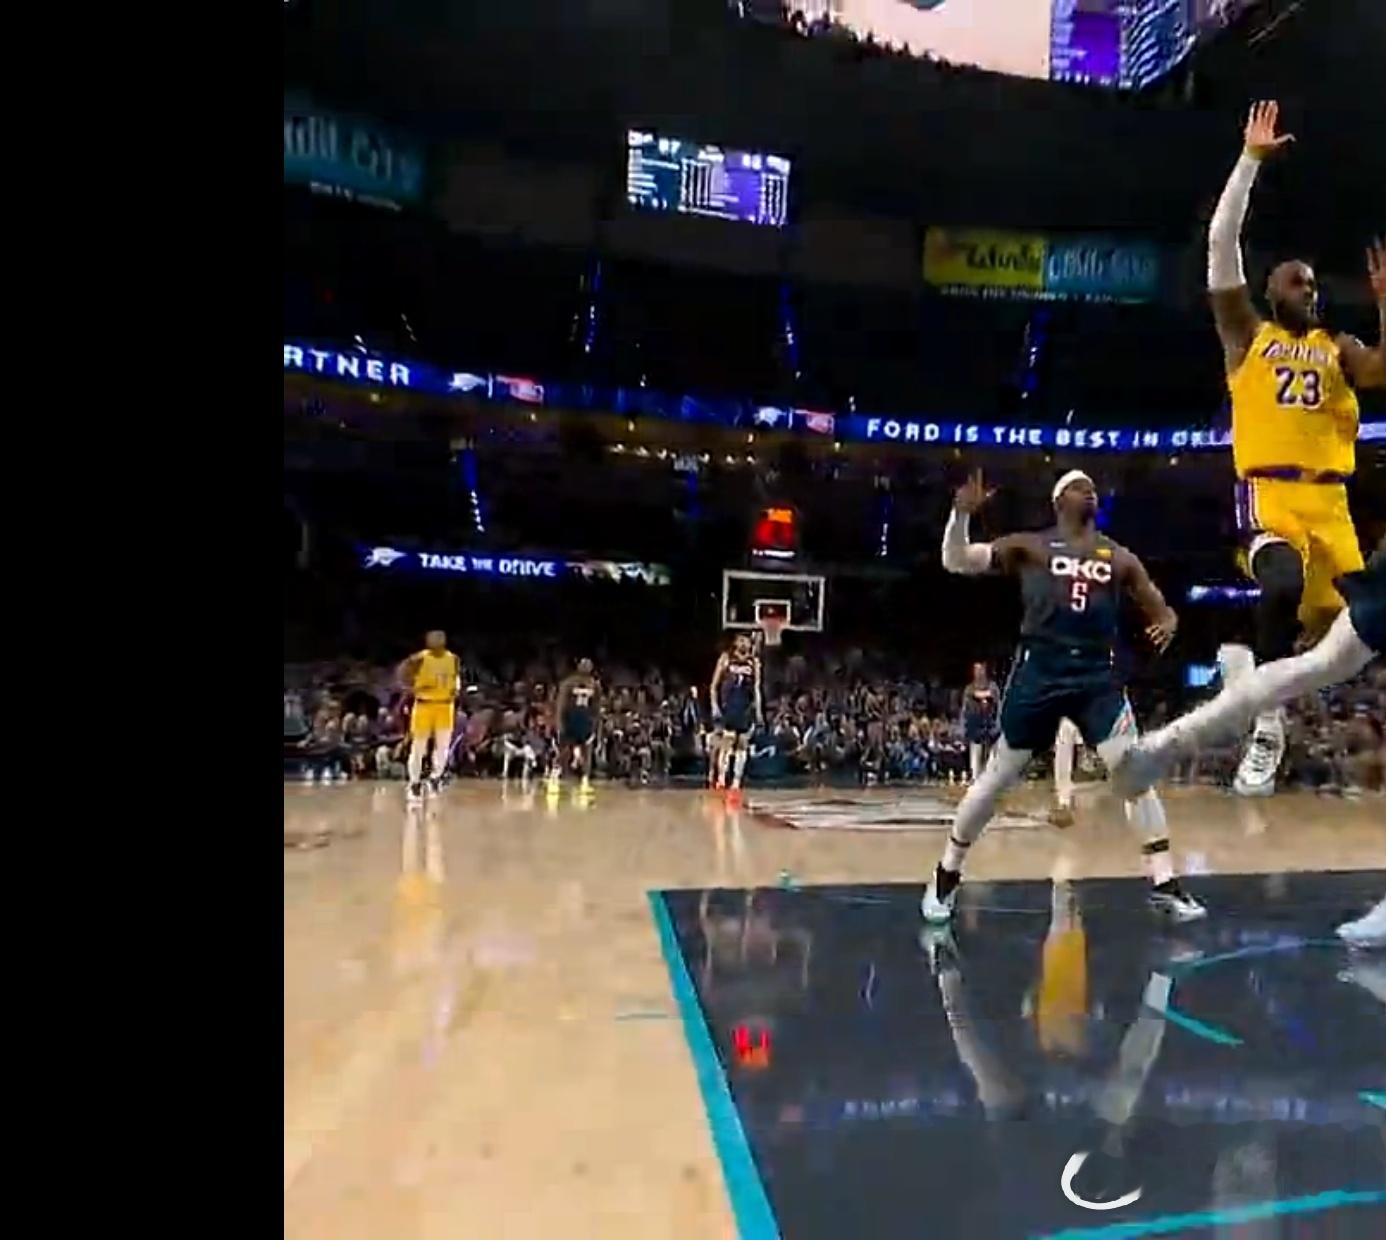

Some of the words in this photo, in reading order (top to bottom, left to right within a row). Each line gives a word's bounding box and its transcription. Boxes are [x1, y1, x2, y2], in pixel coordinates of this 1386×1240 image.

[1274, 364, 1325, 410] 23
[866, 418, 940, 442] FORD
[954, 423, 979, 443] IS
[993, 426, 1042, 446] THE
[1056, 428, 1120, 448] BEST
[1133, 430, 1159, 448] IN
[418, 552, 467, 572] TAKE
[499, 558, 557, 577] DRIVE
[1050, 556, 1112, 583] OKC
[1070, 581, 1089, 613] 5
